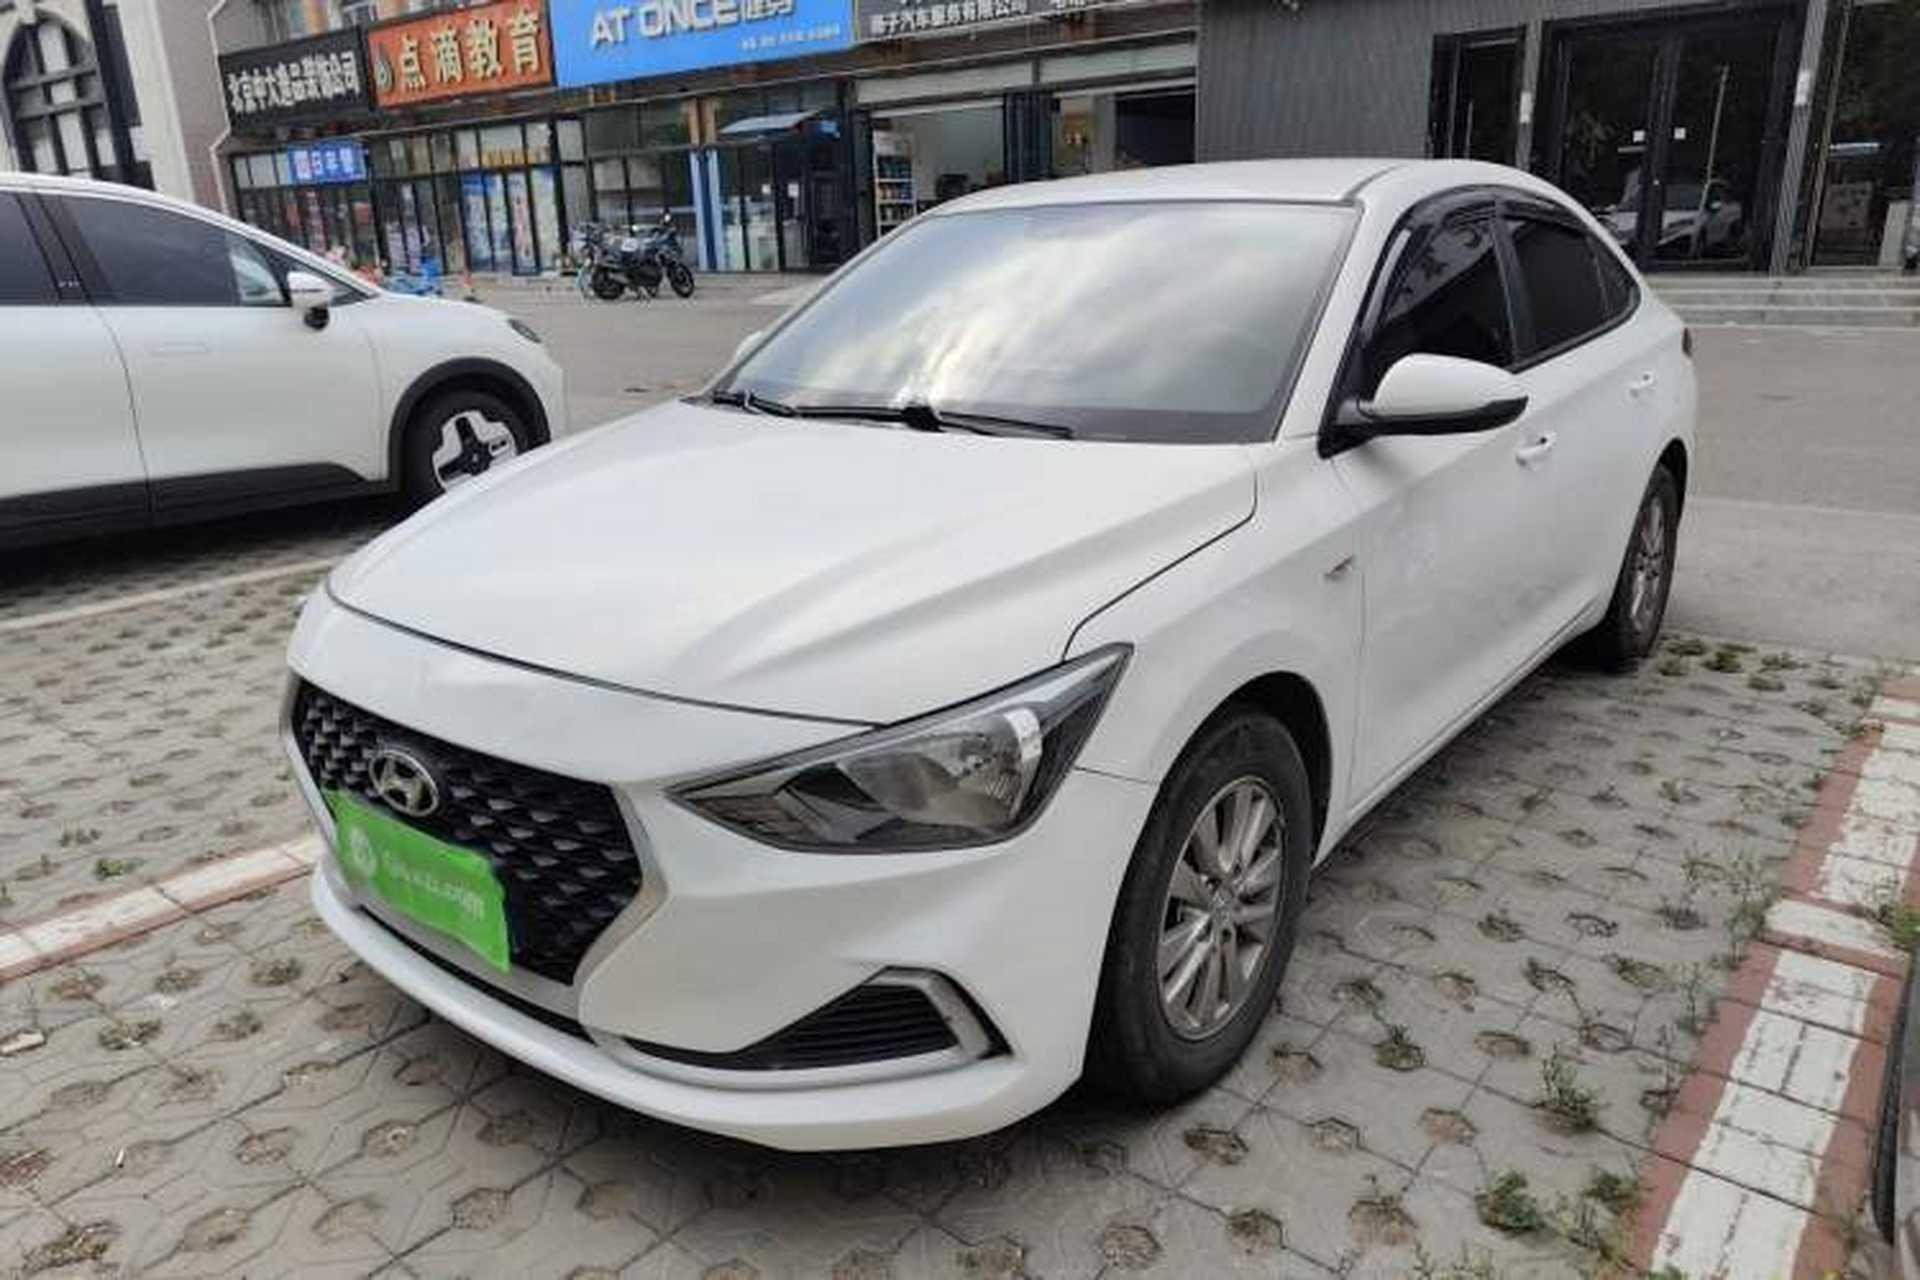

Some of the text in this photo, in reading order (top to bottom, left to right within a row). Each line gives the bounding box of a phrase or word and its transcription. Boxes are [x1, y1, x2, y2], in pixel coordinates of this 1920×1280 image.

[401, 9, 540, 90] 点滴教育
[592, 8, 630, 44] AT
